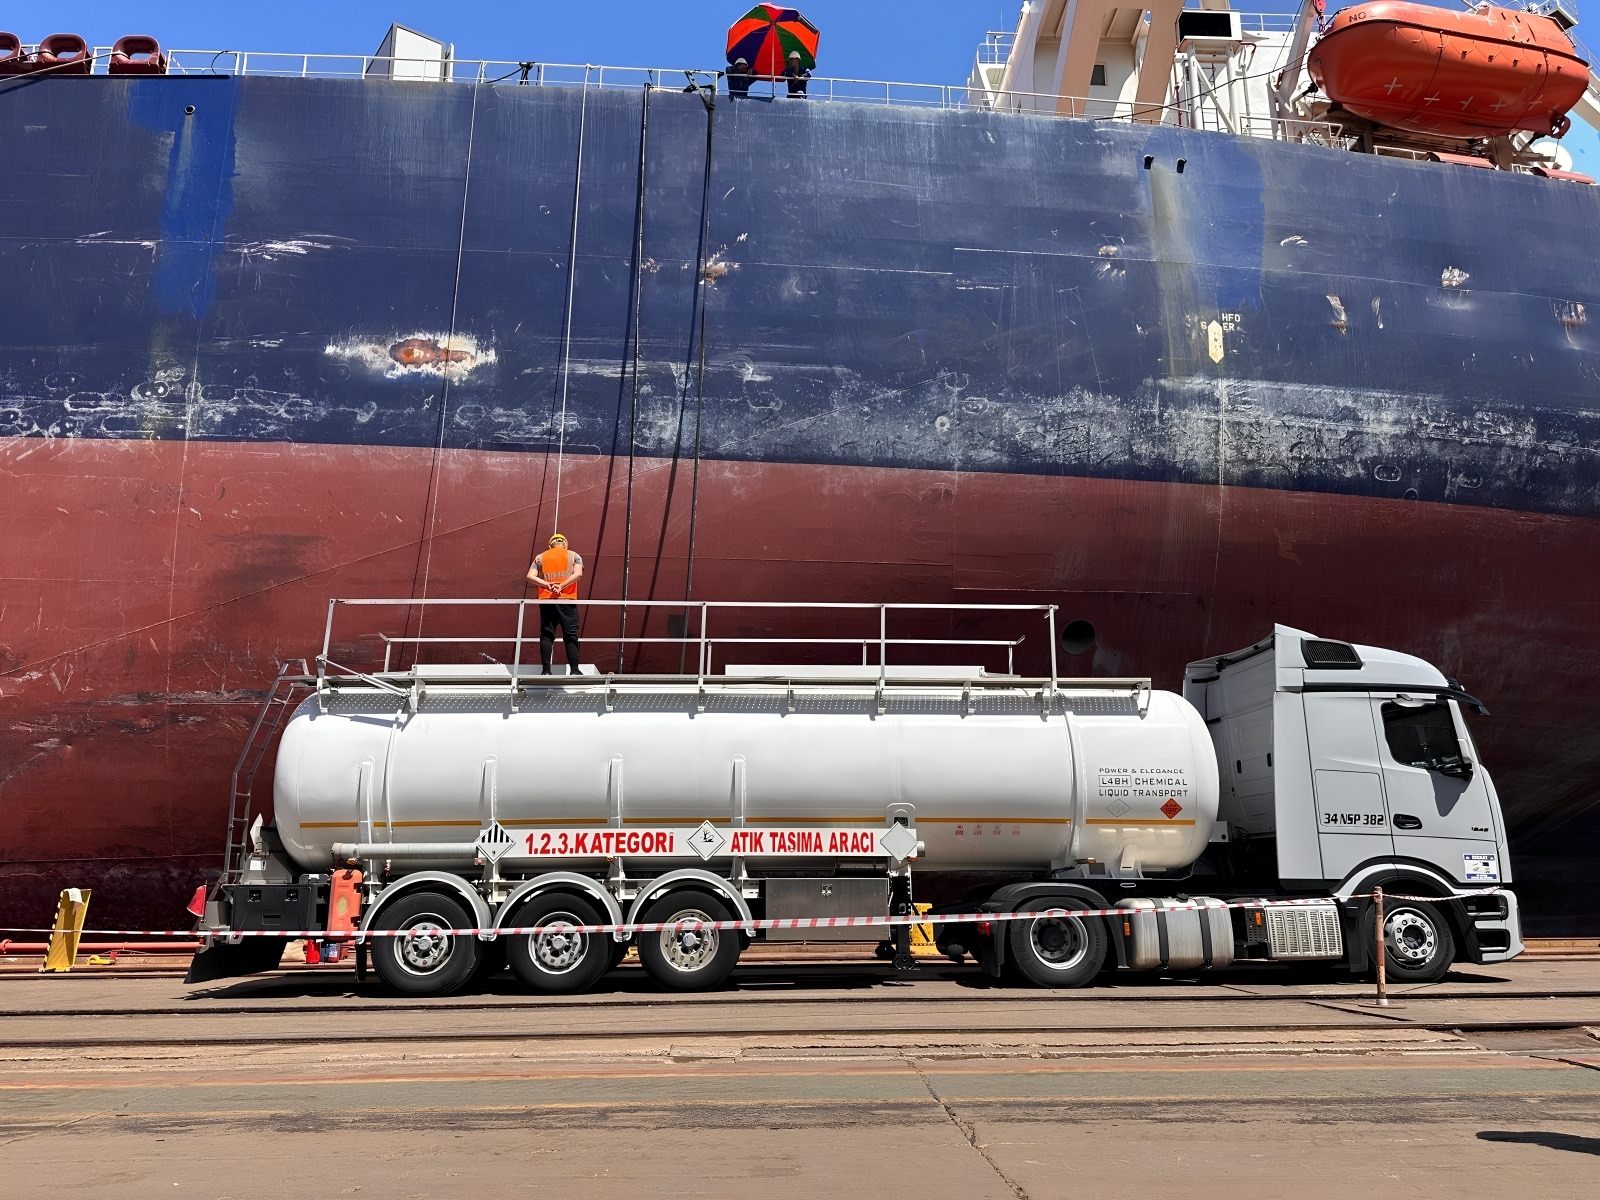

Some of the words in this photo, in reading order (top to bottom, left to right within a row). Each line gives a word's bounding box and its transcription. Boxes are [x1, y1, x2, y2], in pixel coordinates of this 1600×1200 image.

[1349, 12, 1367, 23] NO
[1222, 322, 1235, 331] ER
[1101, 777, 1129, 785] L4BH
[1134, 777, 1188, 786] CHEMICAL
[1098, 788, 1129, 798] LIQUID
[1132, 789, 1189, 798] TRANSPORT
[1323, 812, 1339, 825] 34
[1340, 813, 1361, 825] NSP
[1362, 814, 1384, 826] 382
[730, 831, 764, 853] ATIK
[828, 831, 875, 853] ARACI
